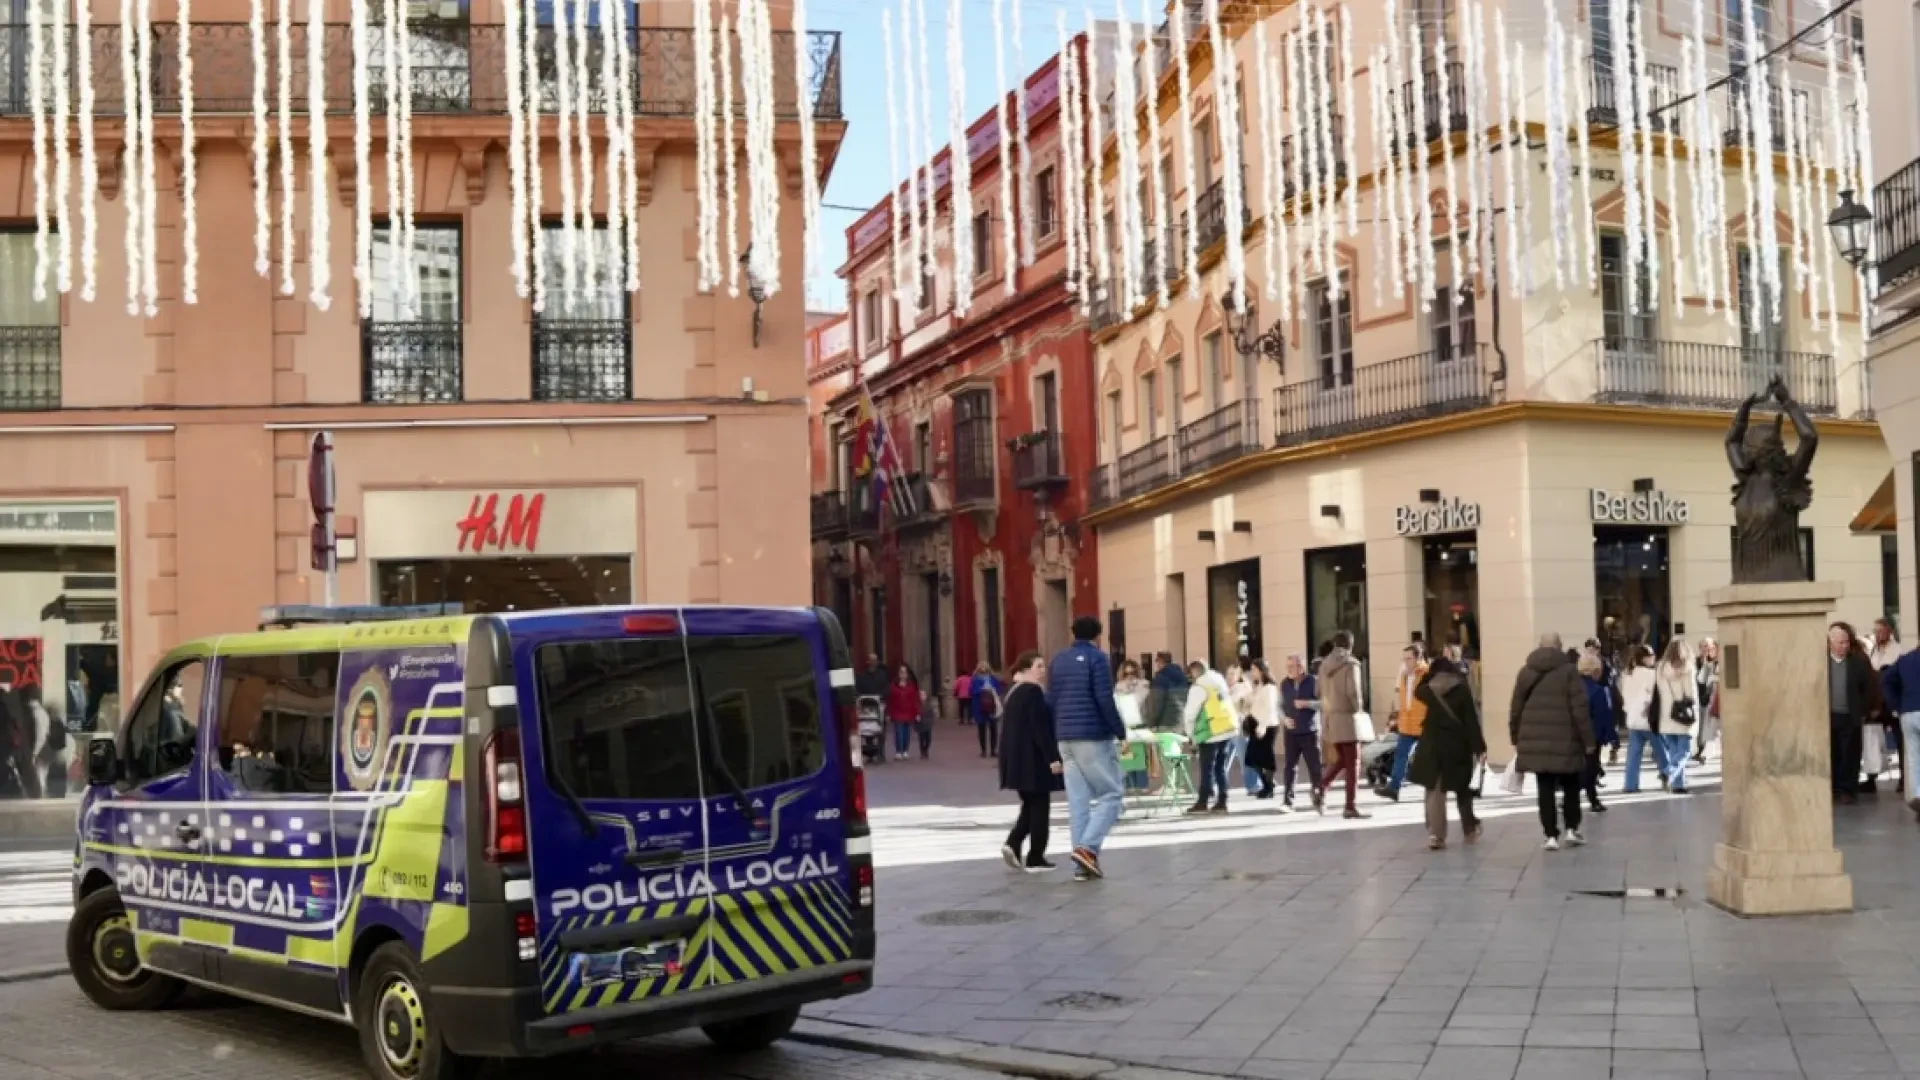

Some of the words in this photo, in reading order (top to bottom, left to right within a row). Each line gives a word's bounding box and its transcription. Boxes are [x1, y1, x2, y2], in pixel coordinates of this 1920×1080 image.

[456, 493, 545, 553] H&M
[1396, 496, 1481, 535] Bershka
[1591, 488, 1690, 522] Bershka
[815, 807, 840, 820] 480
[116, 862, 208, 902] POLICÍA
[213, 871, 304, 918] LOCAL
[551, 864, 717, 917] POLICÍA
[725, 851, 839, 891] LOCAL
